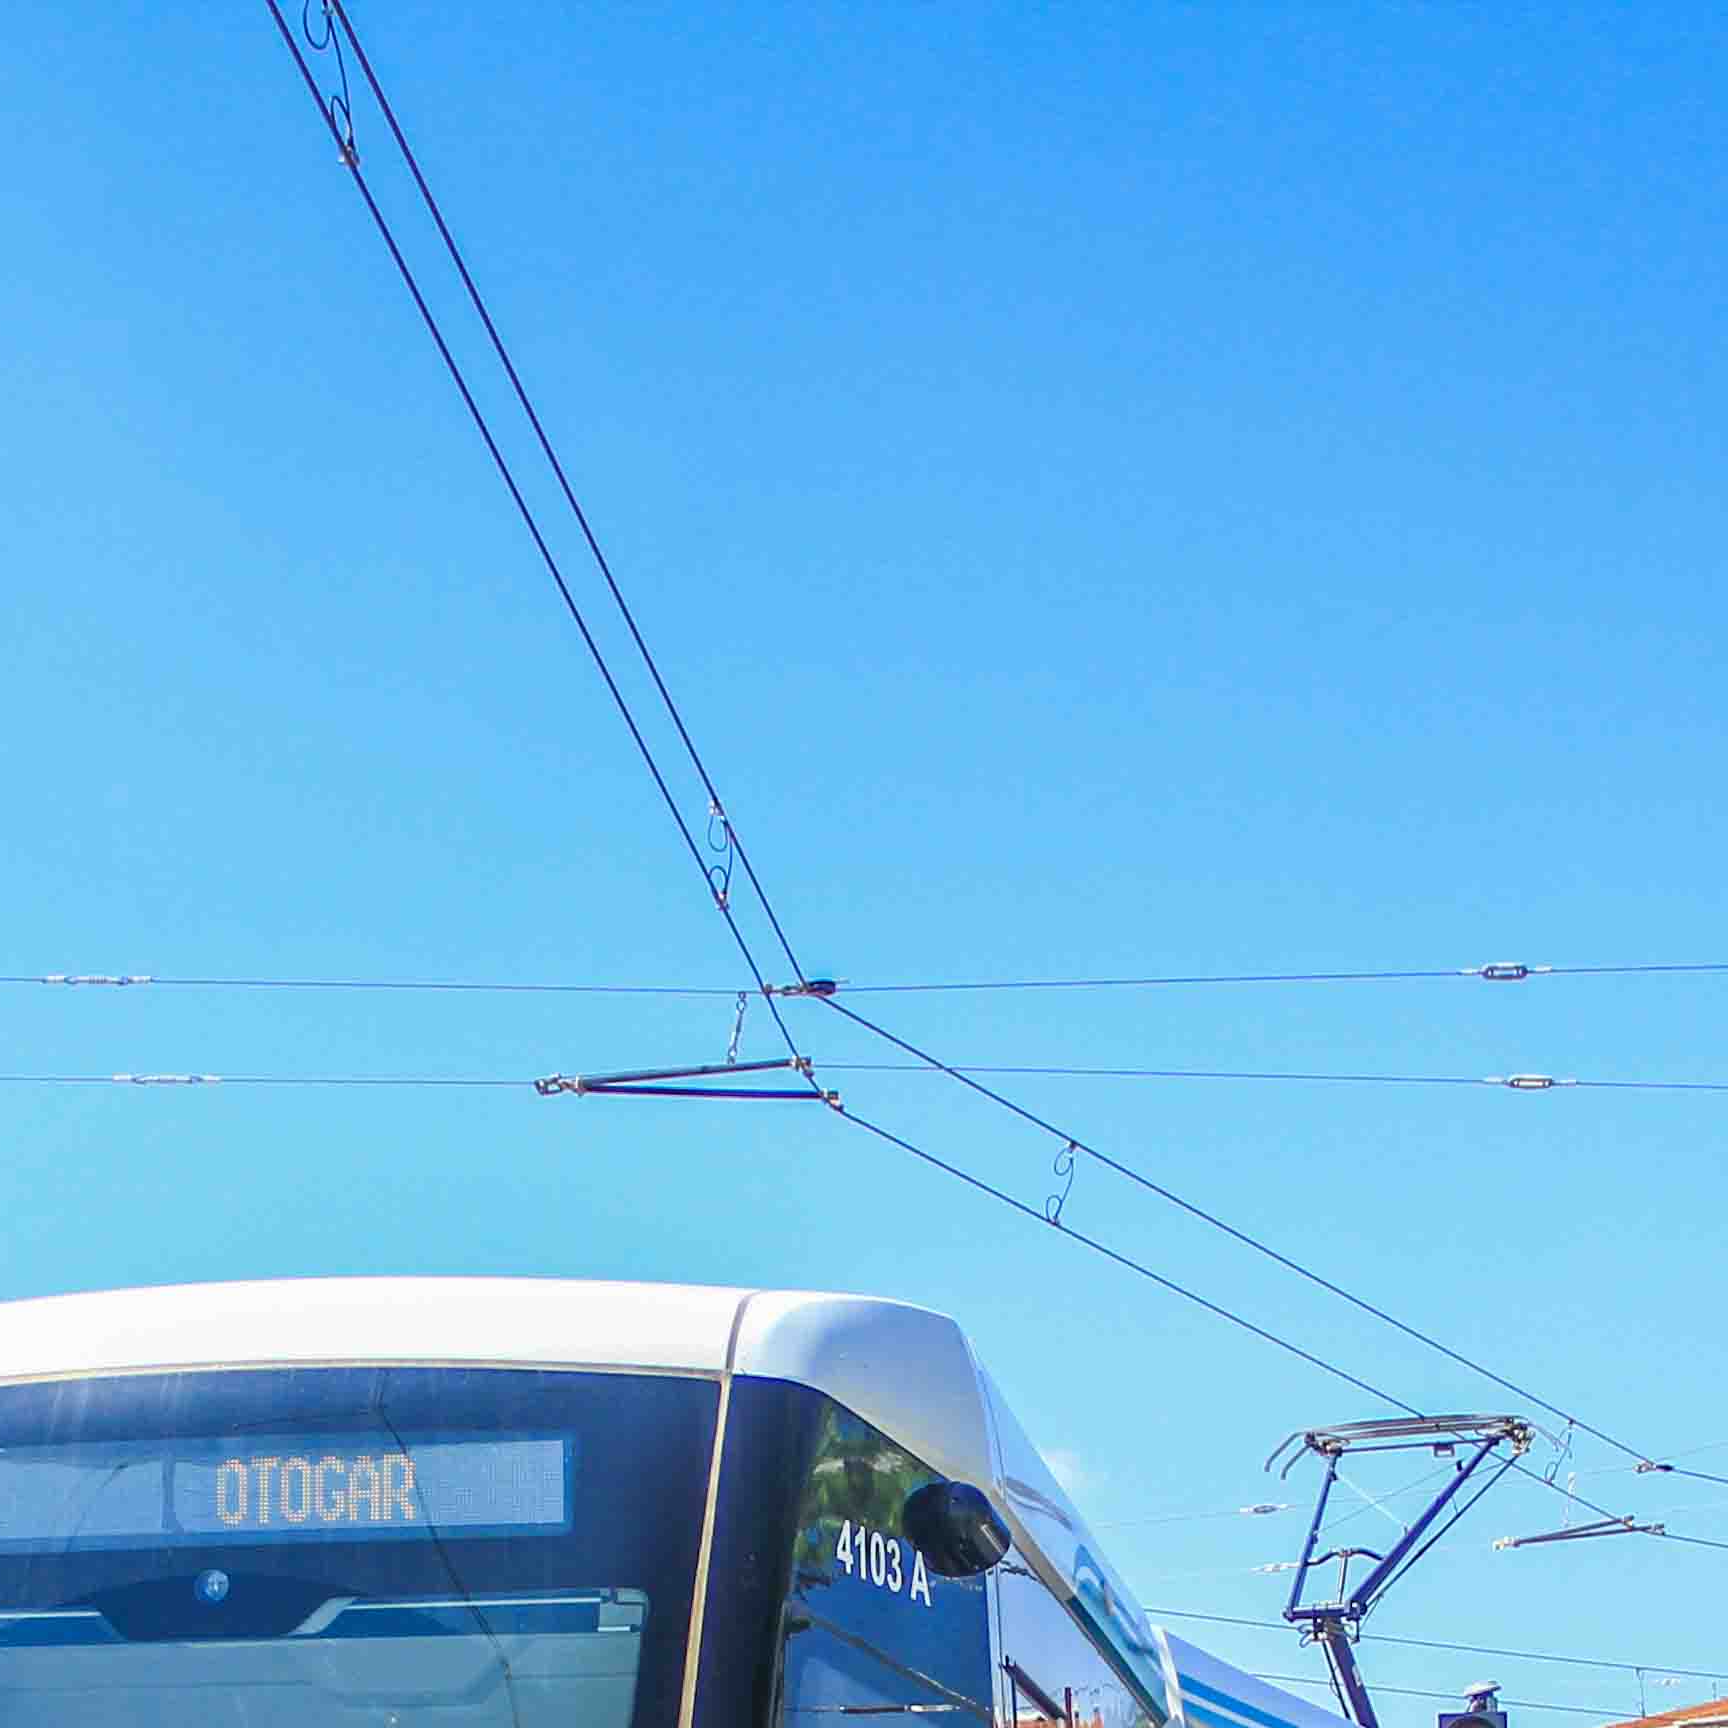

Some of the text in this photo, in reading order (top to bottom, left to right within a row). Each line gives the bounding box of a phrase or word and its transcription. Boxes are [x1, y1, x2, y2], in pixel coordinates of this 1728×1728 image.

[216, 1454, 417, 1528] OTOGAR
[836, 1519, 932, 1607] 4103 A
